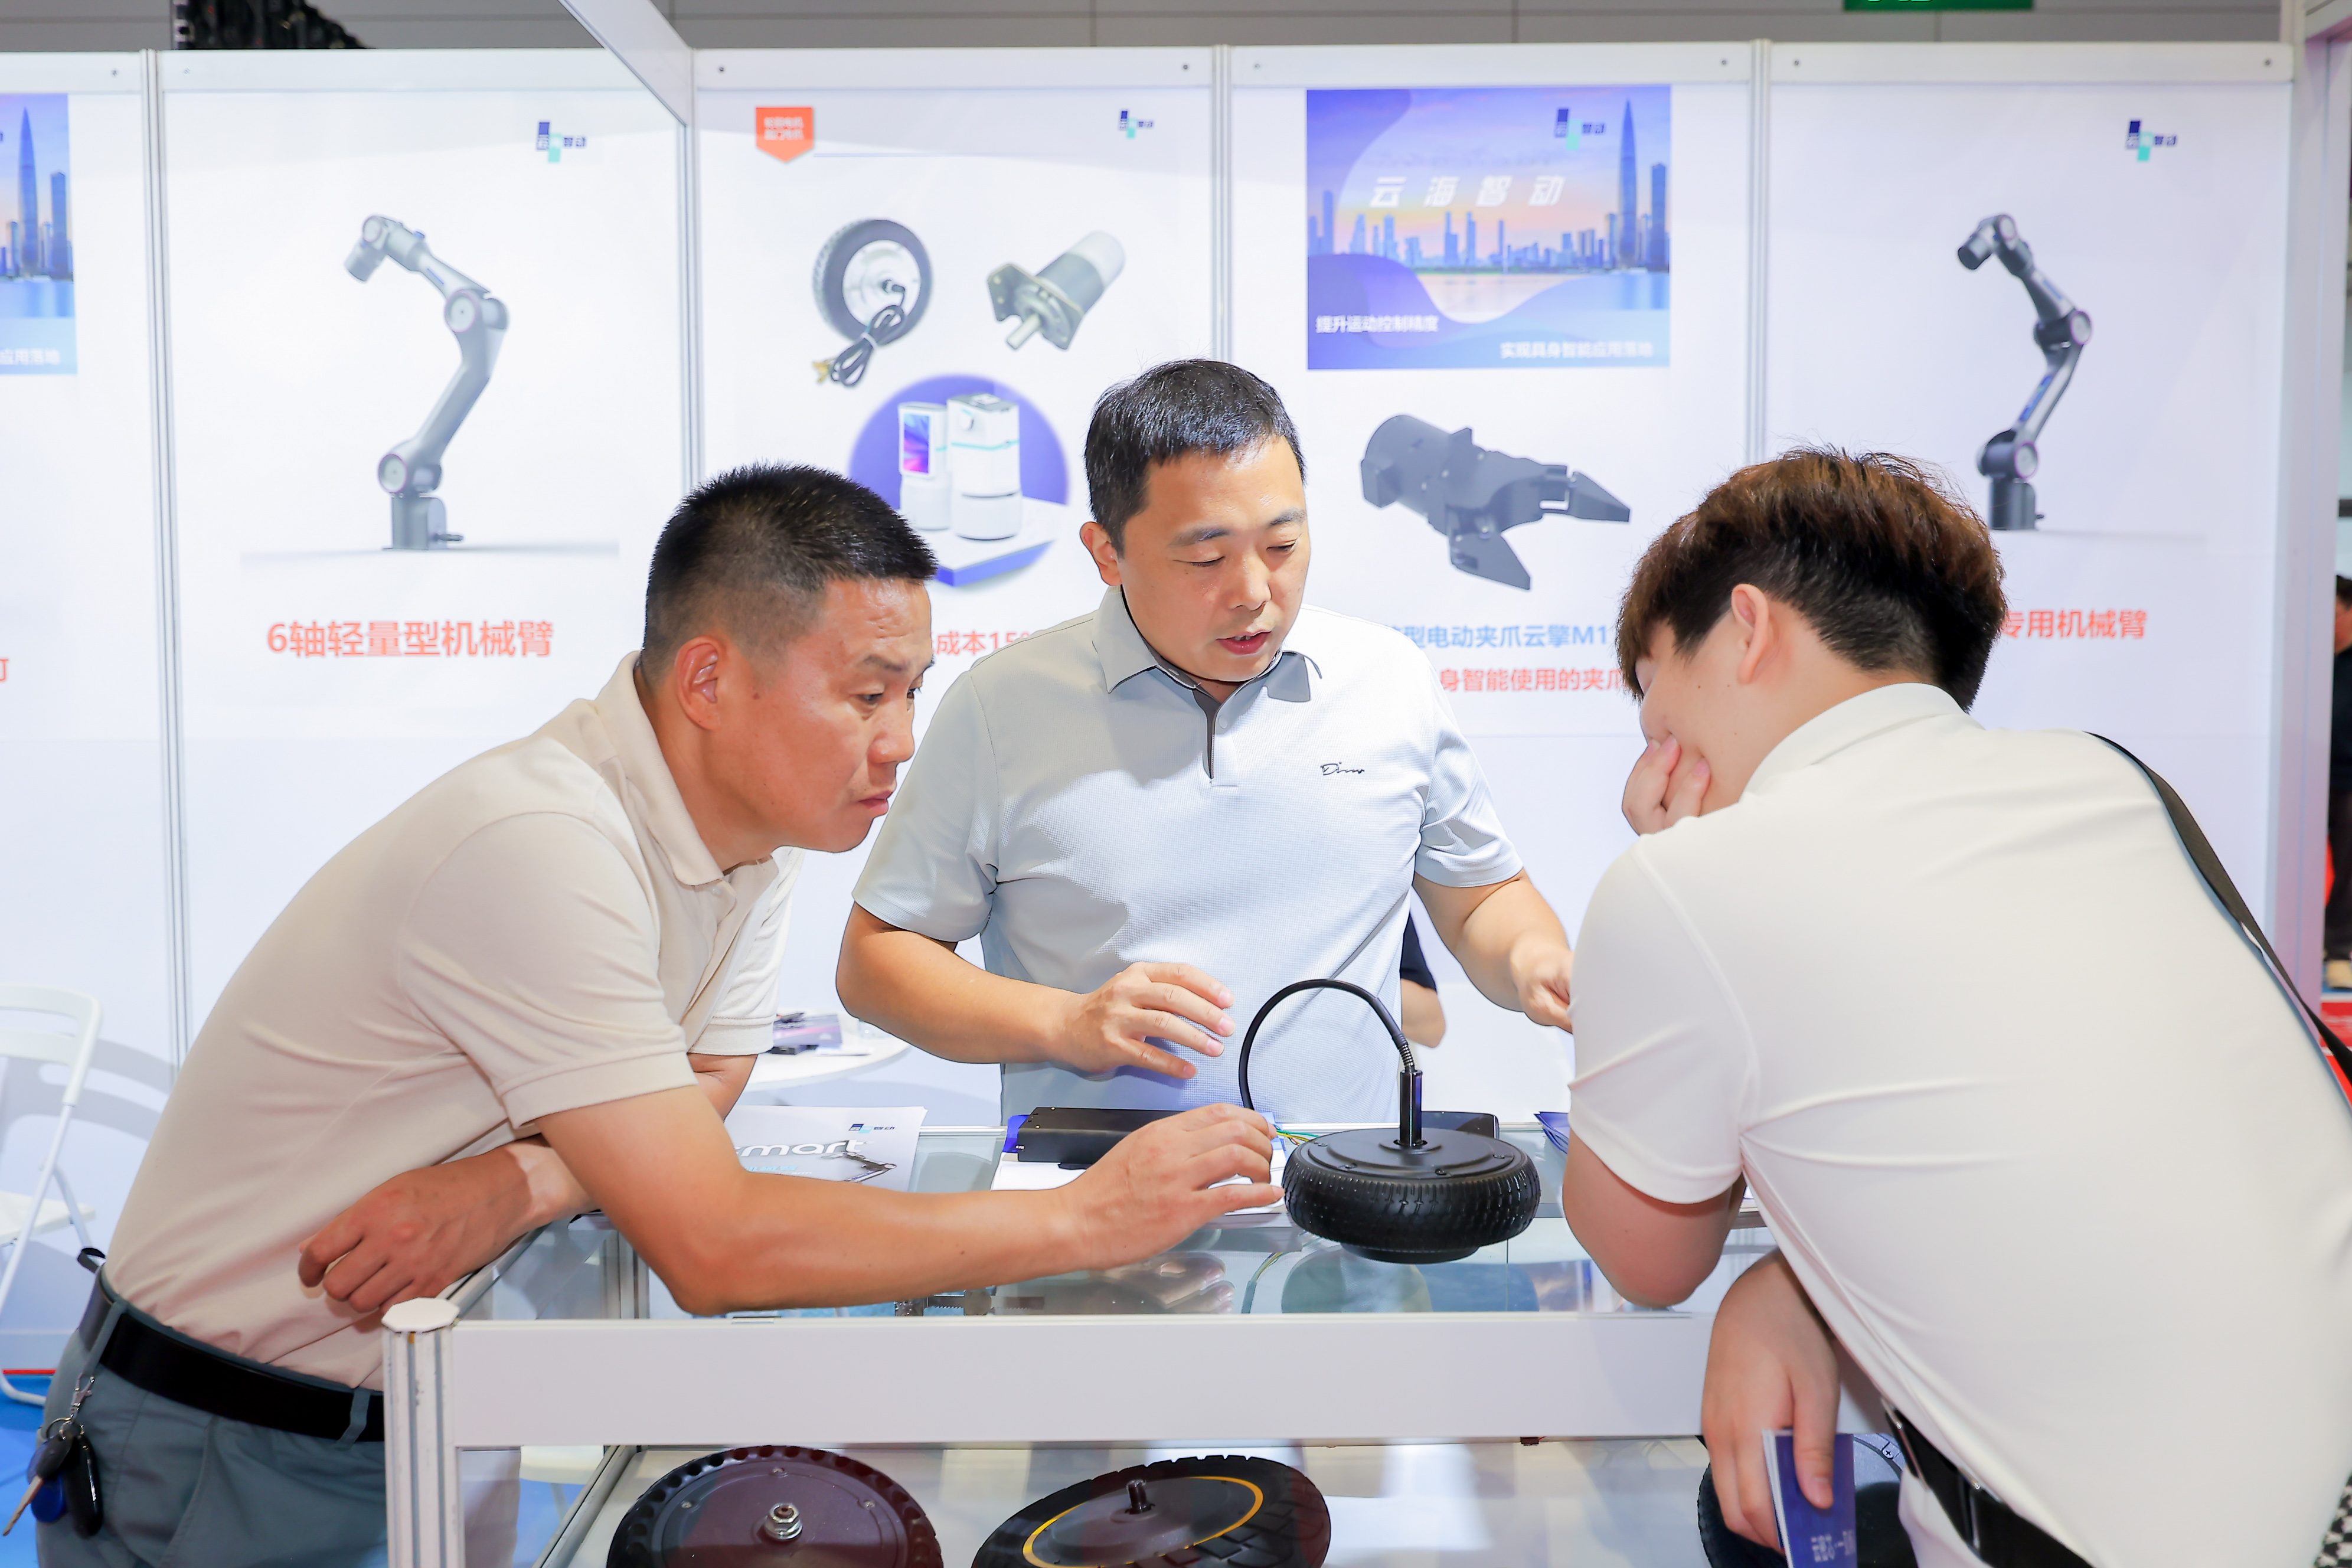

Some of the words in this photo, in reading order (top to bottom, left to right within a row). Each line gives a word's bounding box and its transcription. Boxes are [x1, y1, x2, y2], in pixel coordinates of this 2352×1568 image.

[1370, 176, 1566, 207] 云海智动
[267, 620, 554, 658] 6轴轻量型机械臂
[1393, 625, 1607, 649] 型电动夹爪云擎M1
